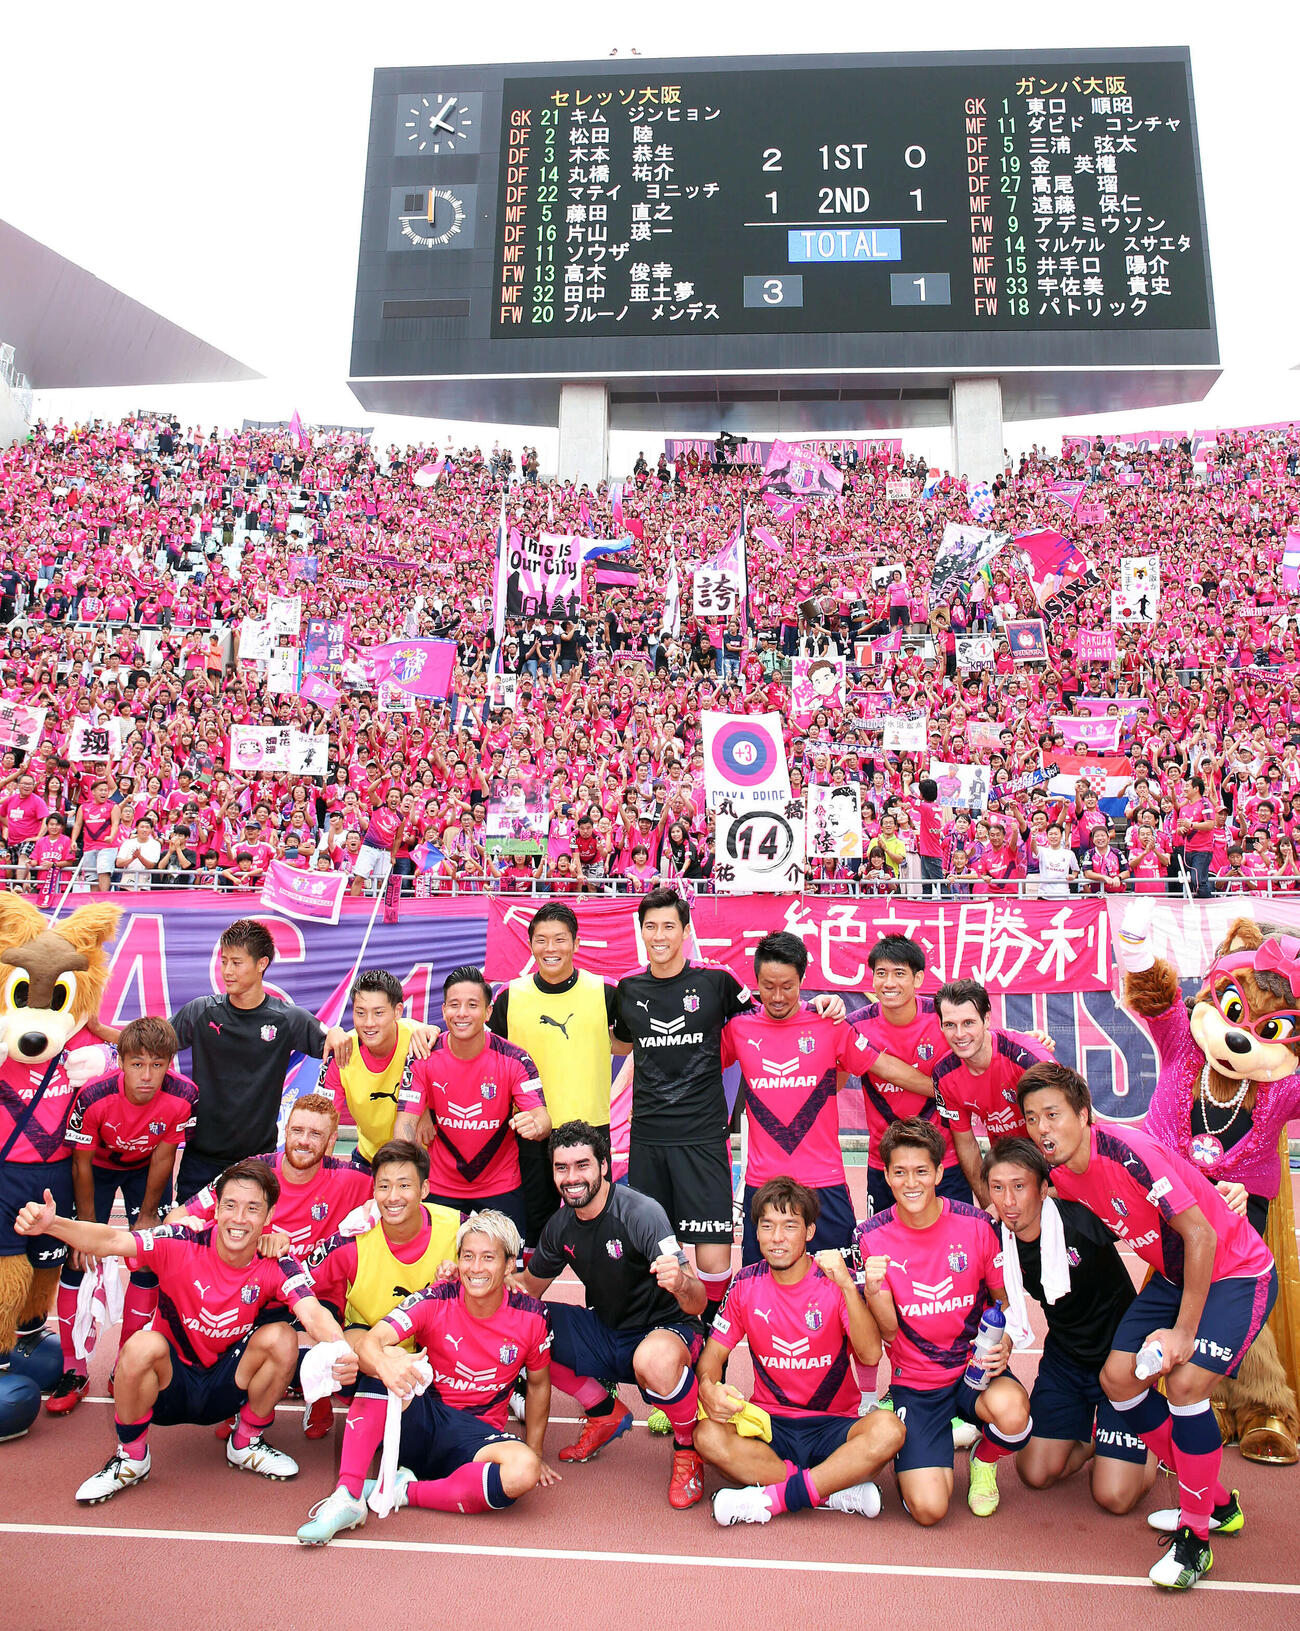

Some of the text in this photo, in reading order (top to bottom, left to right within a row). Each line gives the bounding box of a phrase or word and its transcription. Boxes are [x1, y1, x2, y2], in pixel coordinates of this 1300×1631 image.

[551, 86, 681, 106] セレッソ大阪
[1016, 76, 1127, 95] ガンバ大阪
[511, 106, 720, 126] GK 21 キム ジンヒョン
[965, 97, 1133, 117] GK 1 東口 順昭
[510, 125, 653, 145] DF 2 松田 陸
[966, 115, 1180, 134] MF 11 ダビド コンチャ
[509, 144, 674, 164] DF 3 木本 恭生
[967, 135, 1137, 155] DF 5 三浦 弦太
[763, 148, 782, 171] 2
[819, 144, 867, 170] 1ST
[968, 156, 989, 173] DF
[1000, 156, 1020, 172] 19
[1030, 156, 1050, 176] 金
[508, 163, 674, 183] DF 14 丸橋 祐介
[507, 182, 719, 203] DF 22 マテイ ヨニッチ
[969, 176, 990, 192] DF
[1001, 176, 1020, 192] 27
[766, 187, 922, 213] 1 2ND 1
[970, 192, 1142, 217] MF 7 遠藤 保仁
[506, 202, 673, 225] MF 5 藤田 直之
[505, 225, 526, 242] DF
[537, 225, 556, 241] 16
[566, 222, 607, 244] 片山
[971, 215, 1165, 234] FW 9 アデミウソン
[504, 241, 630, 262] MF 11 ソウザ
[801, 231, 889, 259] TOTAL
[972, 235, 1190, 253] MF 14 マルケル スサエタ
[503, 262, 673, 283] FW 13 高木 俊幸
[973, 255, 1169, 277] MF 15 井手口 陽介
[502, 280, 694, 303] MF 32 田中 亜土夢
[762, 277, 926, 304] 3 1
[974, 274, 1171, 296] FW 33 宇佐美 貴史
[501, 300, 719, 323] FW 20 ブルーノ メンデス
[975, 298, 1147, 316] FW 18 パトリック
[520, 533, 571, 558] This Is
[511, 551, 577, 580] Our City
[697, 573, 735, 610] 誇
[328, 623, 344, 660] 清武
[1081, 635, 1112, 646] SAKURA
[2, 706, 30, 747] 亜土夢
[81, 728, 109, 755] 翔
[735, 744, 752, 762] +3
[718, 798, 804, 820] 丸 橋
[738, 825, 778, 861] 14
[840, 831, 859, 857] 2
[715, 862, 804, 885] 祐 介
[638, 1032, 703, 1049] YANMAR
[750, 1075, 817, 1089] YANMAR
[435, 1113, 500, 1131] YANMAR
[679, 1219, 733, 1234] ナカバヤシ
[899, 1292, 975, 1317] YANMAR
[182, 1312, 256, 1339] YANMAR
[758, 1354, 832, 1370] YANMAR
